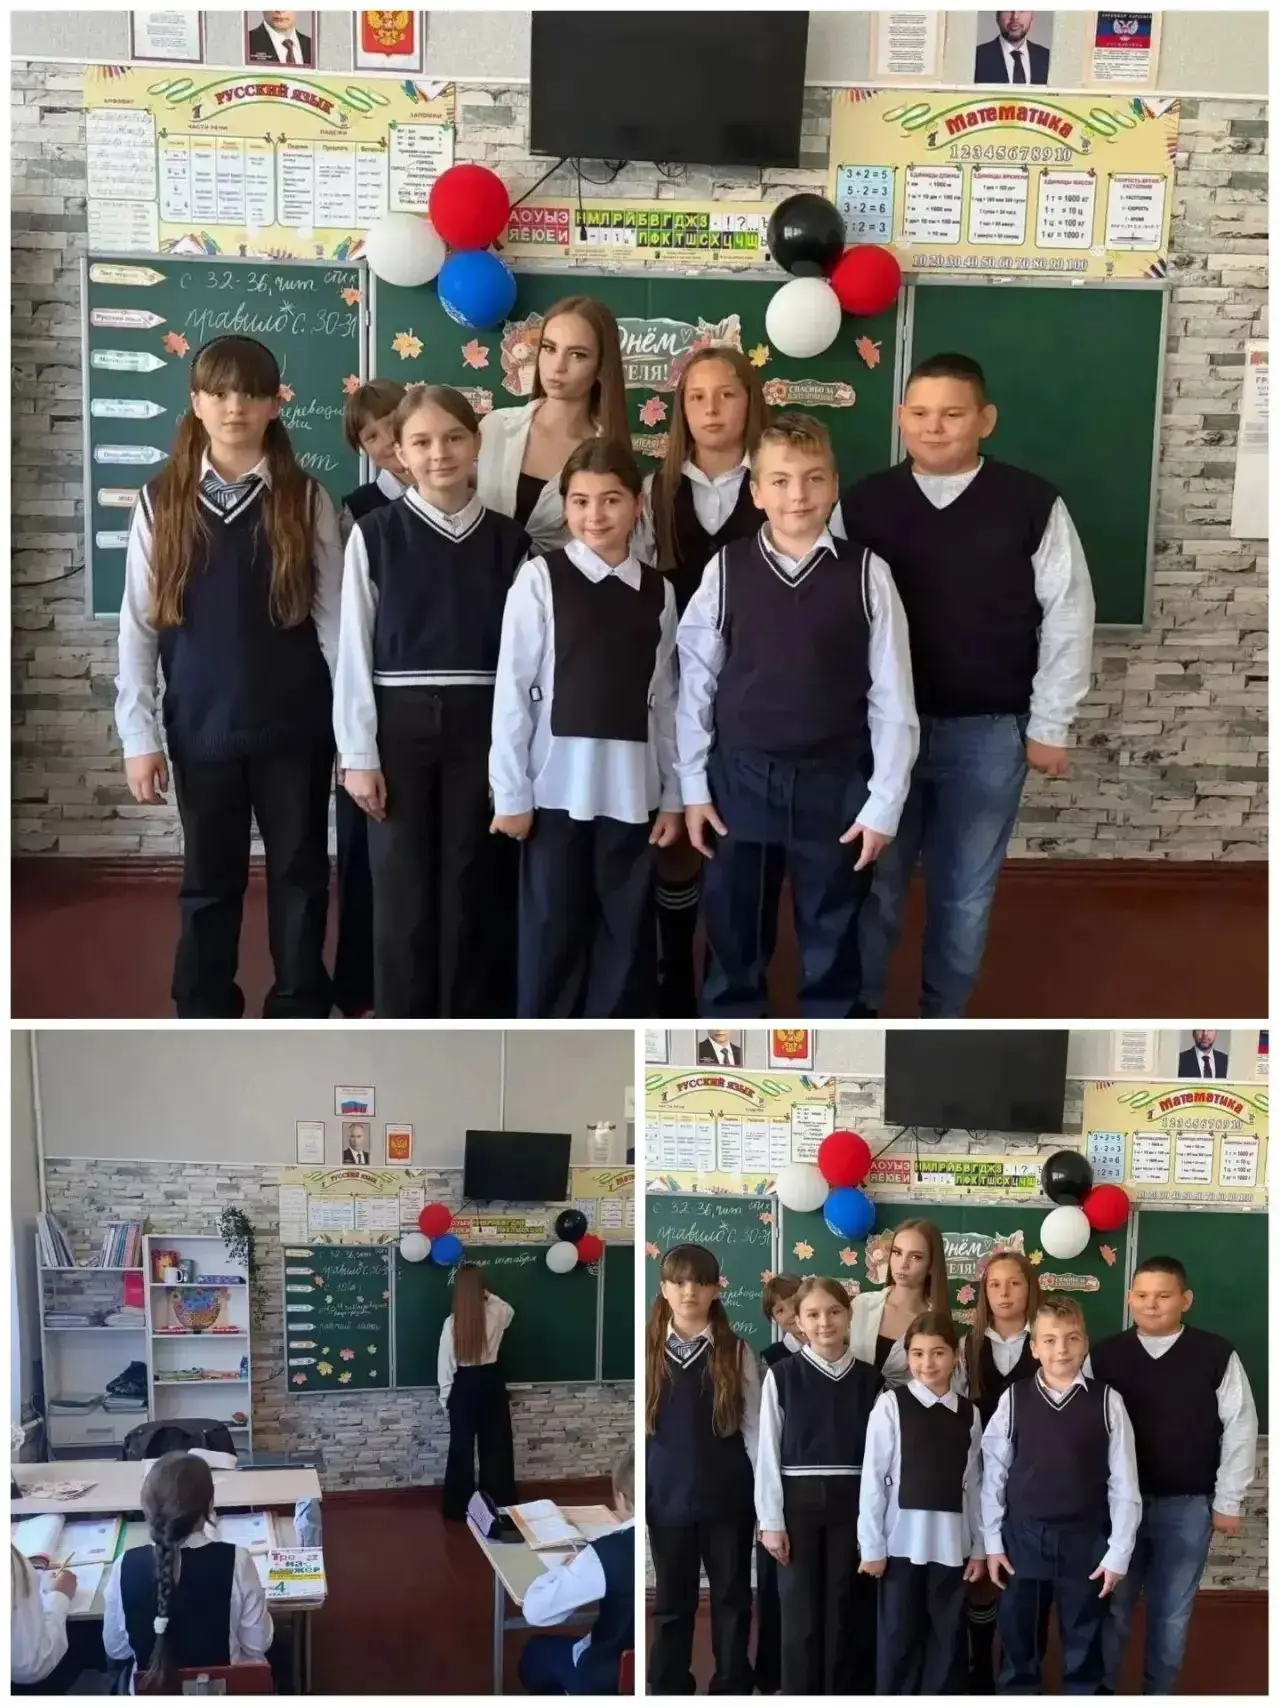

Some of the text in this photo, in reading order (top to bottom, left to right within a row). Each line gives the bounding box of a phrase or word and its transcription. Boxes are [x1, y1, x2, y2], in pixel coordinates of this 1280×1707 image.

[214, 83, 334, 115] РУССКИЙ ЯЗЫК
[945, 104, 1074, 139] Математика
[846, 169, 852, 178] 3
[864, 169, 870, 178] 2
[881, 170, 887, 178] 5
[847, 186, 854, 195] 5
[863, 186, 869, 195] 2
[881, 187, 887, 195] 3
[844, 203, 850, 212] 3
[860, 203, 866, 213] 2
[879, 203, 886, 213] 6
[859, 221, 865, 232] 2
[879, 222, 886, 232] 3
[1065, 219, 1077, 227] 100
[1064, 231, 1080, 239] 1000
[676, 1077, 756, 1098] РУССКИЙ ЯЗЫК
[1158, 1092, 1244, 1115] Математика
[275, 1581, 285, 1592] 4
